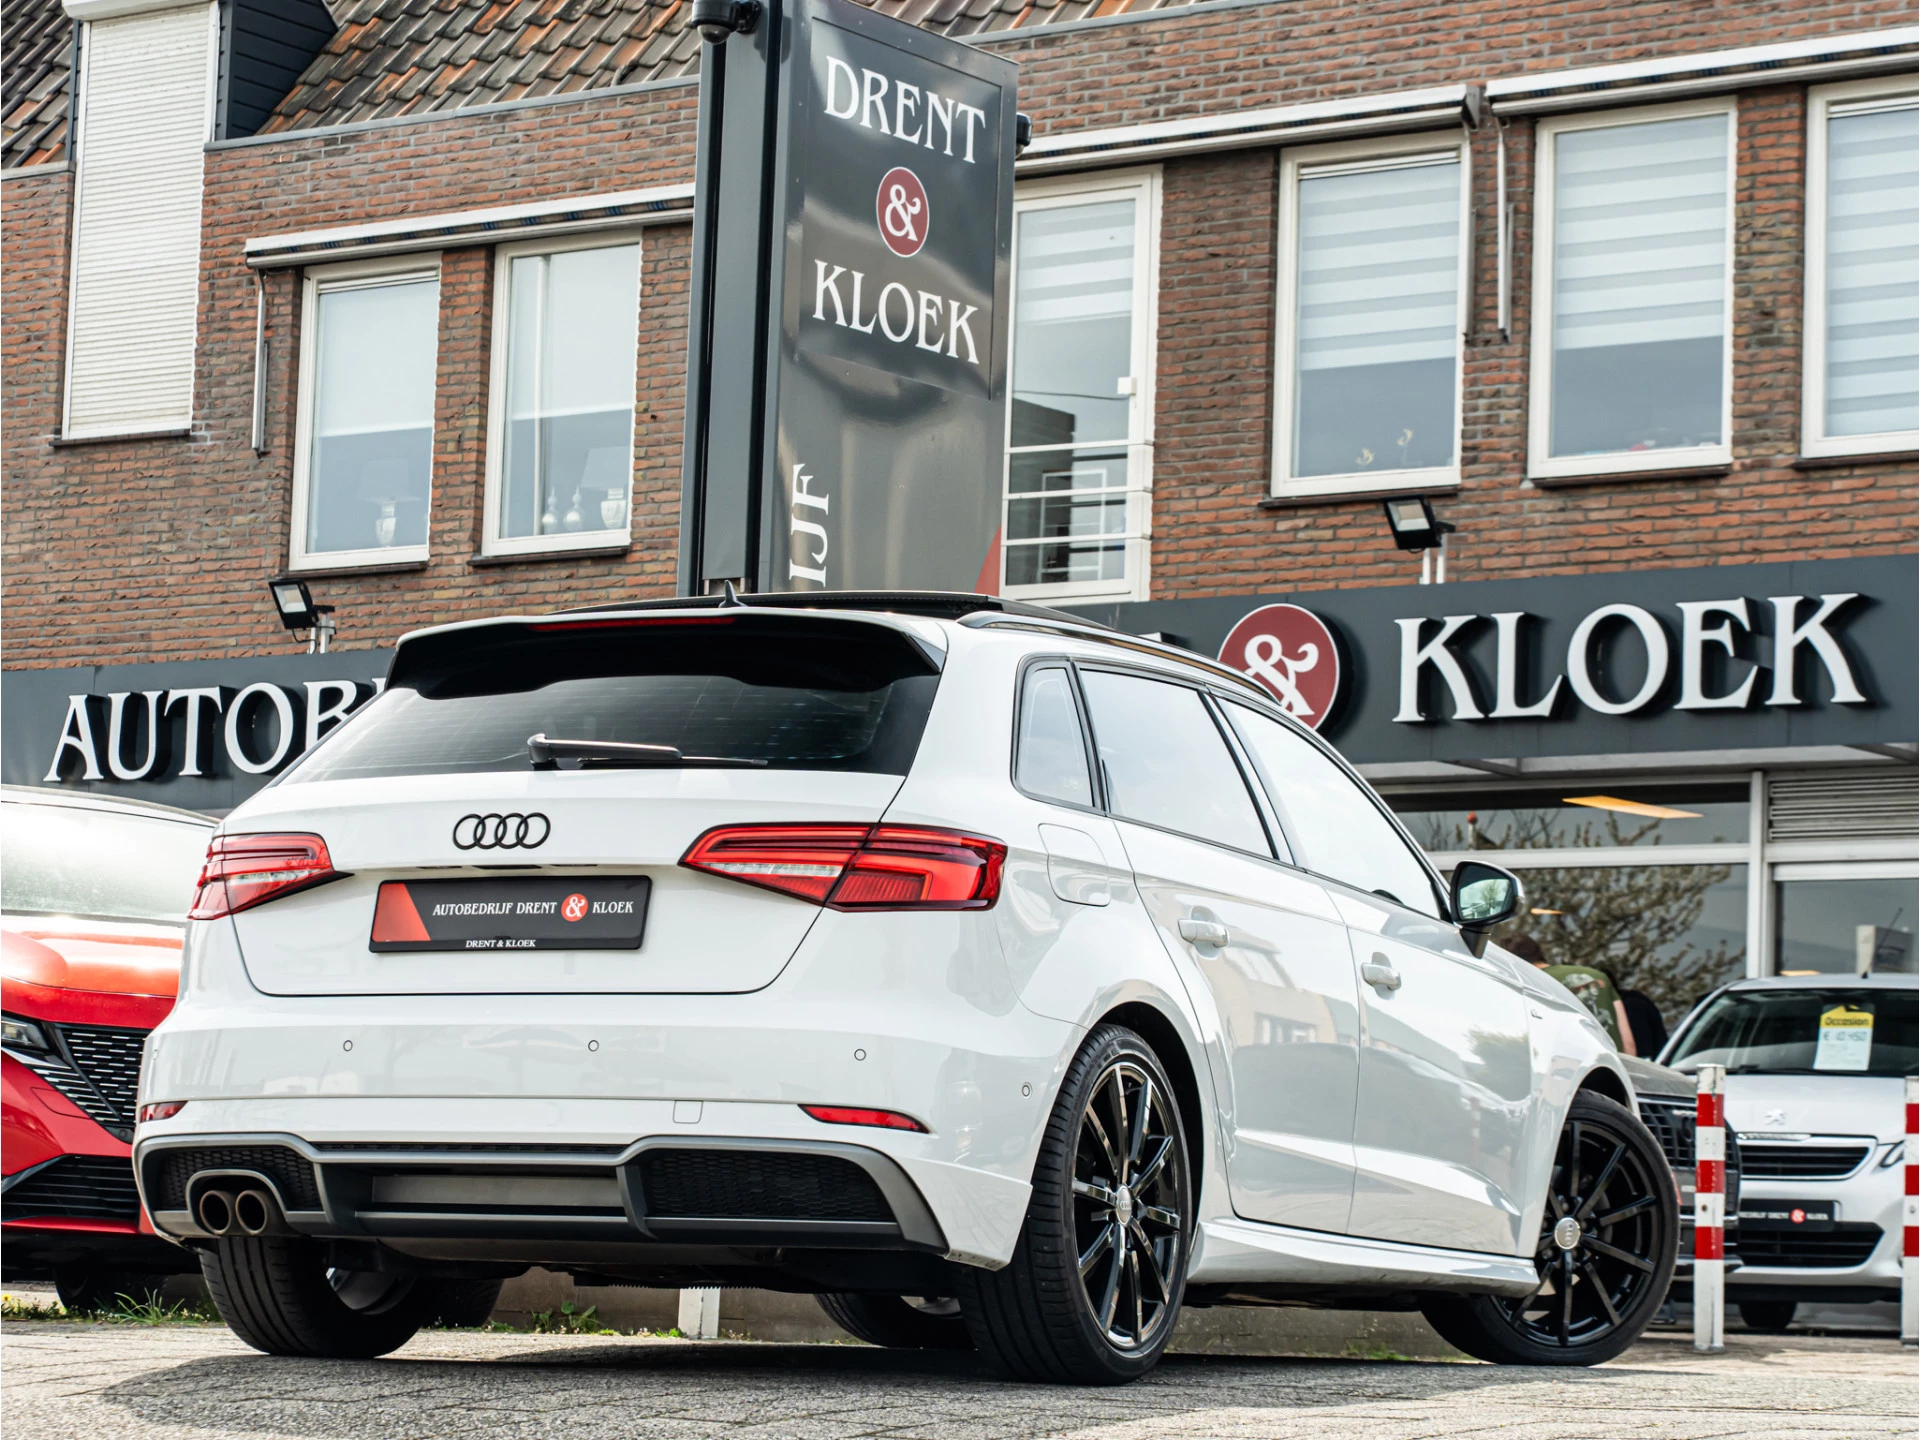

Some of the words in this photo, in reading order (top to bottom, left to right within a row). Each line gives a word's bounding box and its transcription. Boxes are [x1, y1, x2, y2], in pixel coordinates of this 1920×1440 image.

[824, 55, 986, 164] DRENT
[884, 184, 921, 242] &
[812, 258, 980, 365] KLOEK
[1243, 634, 1319, 716] &
[1391, 592, 1868, 723] KLOEK
[42, 677, 387, 783] AUTOB
[432, 902, 513, 916] AUTOBEDRIJF
[516, 901, 557, 914] DRENT
[565, 896, 586, 918] &
[592, 901, 634, 914] KLOEK
[465, 939, 497, 948] DRENT
[497, 939, 504, 948] &
[505, 939, 536, 948] KLOEK
